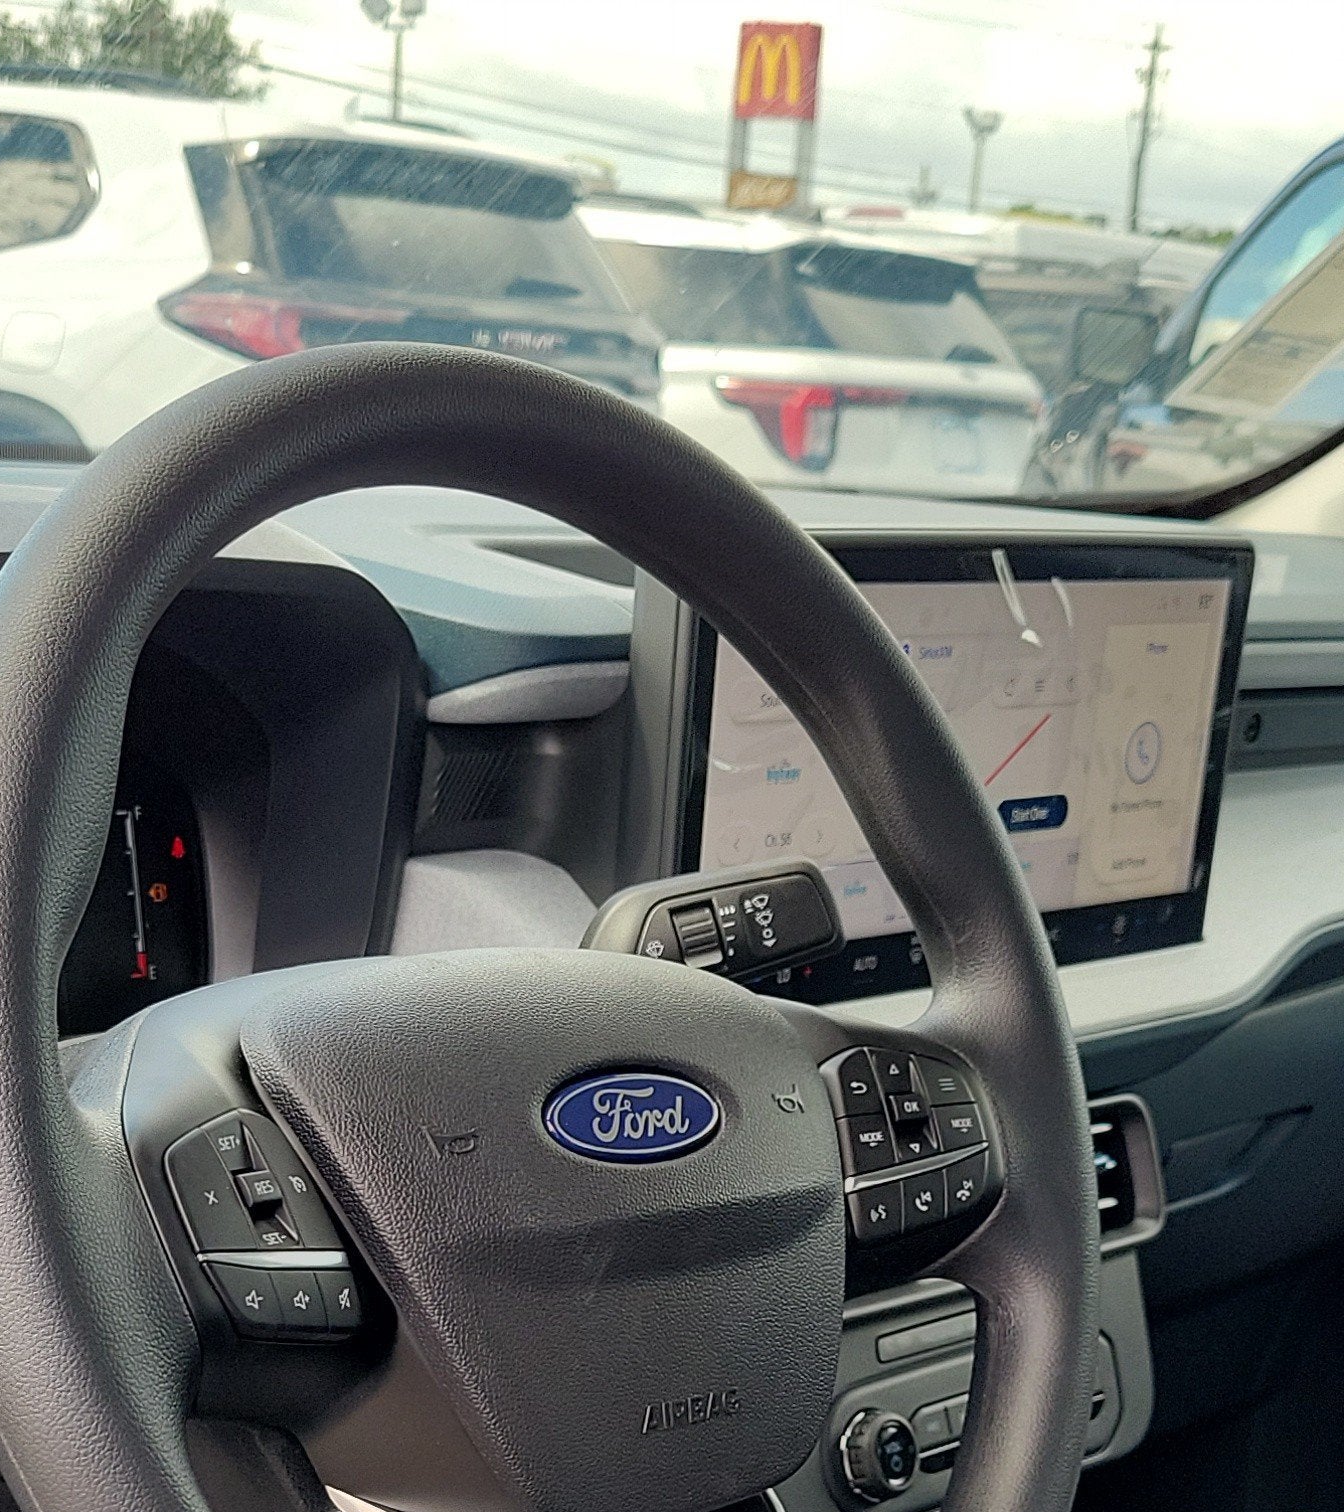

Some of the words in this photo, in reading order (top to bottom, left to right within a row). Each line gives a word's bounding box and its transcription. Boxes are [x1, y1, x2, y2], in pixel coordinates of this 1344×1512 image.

[134, 805, 142, 821] F
[853, 955, 878, 972] AUTO
[149, 964, 157, 980] E
[591, 1086, 690, 1143] Ford
[904, 1101, 920, 1113] OK
[950, 1117, 973, 1128] MODE
[859, 1130, 885, 1143] MODE
[254, 1179, 274, 1196] RES
[641, 1387, 744, 1435] AIRBAG
